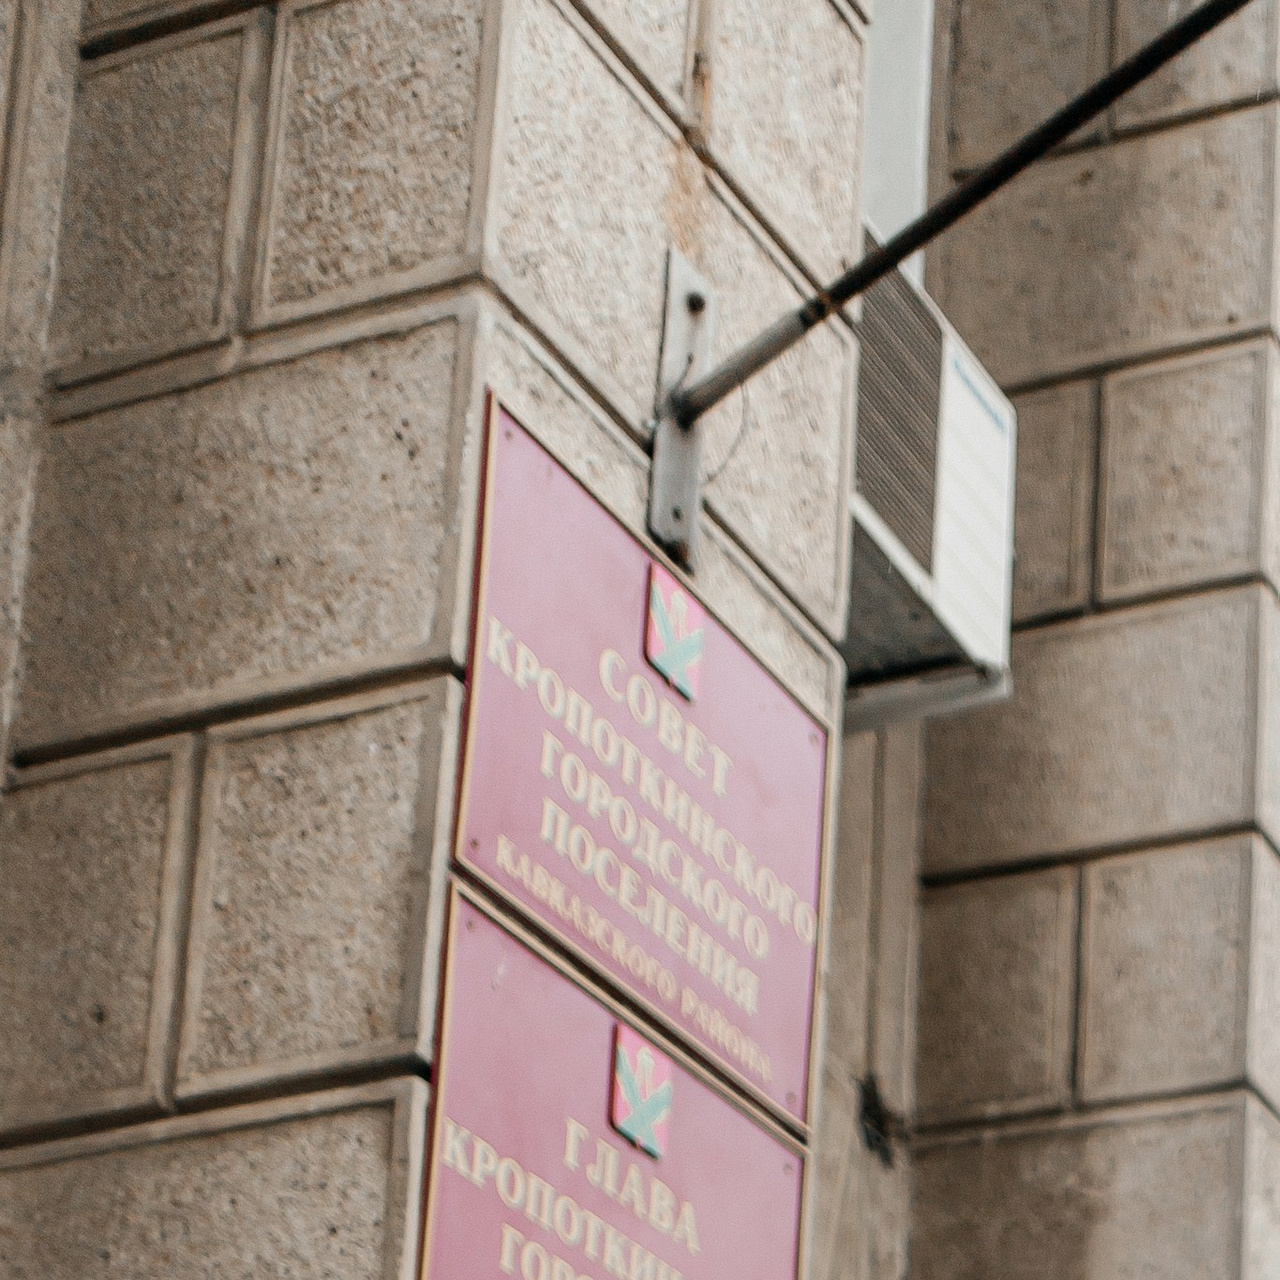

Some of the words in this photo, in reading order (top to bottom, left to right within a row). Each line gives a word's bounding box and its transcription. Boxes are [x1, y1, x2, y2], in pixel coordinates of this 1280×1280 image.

[485, 615, 817, 947] КРОПОТКИНСКОГО
[598, 647, 733, 797] СОВЕТ
[495, 834, 680, 1005] КАВКАЗСКОГО
[541, 729, 770, 962] ГОРОДСКОГО
[541, 797, 760, 1016] ПОСЕЛЕНИЯ
[564, 1117, 700, 1255] ГЛАВА
